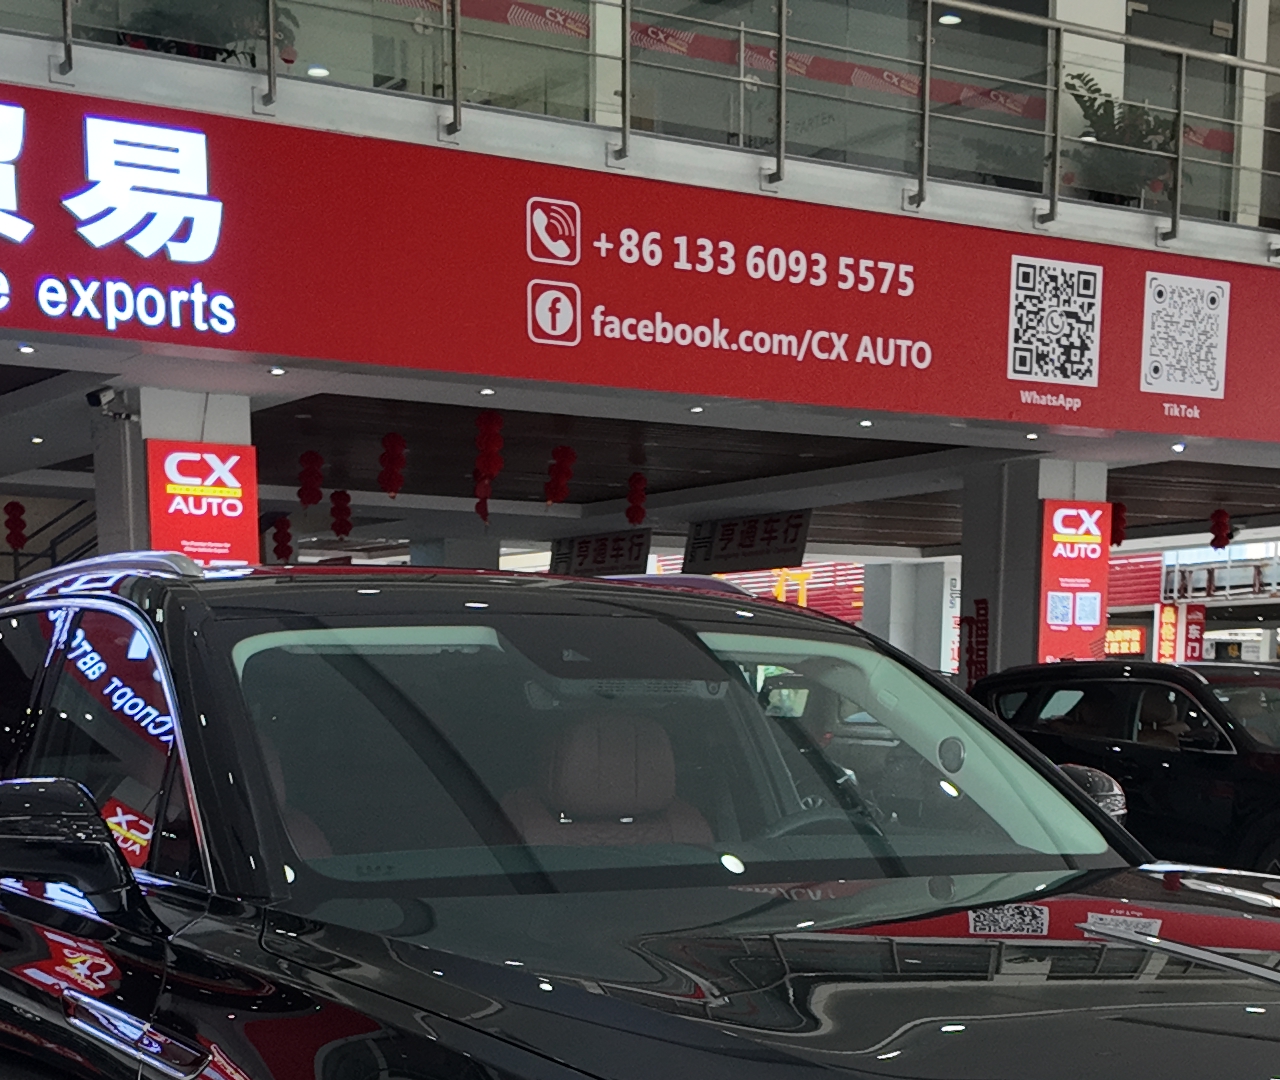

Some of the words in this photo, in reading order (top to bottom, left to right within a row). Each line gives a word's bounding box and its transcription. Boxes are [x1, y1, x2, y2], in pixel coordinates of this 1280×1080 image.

[593, 228, 663, 267] +86
[671, 235, 737, 277] 133
[746, 243, 828, 288] 6093
[837, 254, 916, 298] 5575
[37, 272, 237, 334] exports
[591, 304, 849, 364] facebook.com/CX
[856, 334, 933, 371] AUTO
[1020, 390, 1081, 411] WhatsApp
[1163, 403, 1200, 419] TikTok
[164, 452, 241, 488] CX
[168, 496, 243, 517] AUTO
[1052, 508, 1103, 536] CX
[1052, 543, 1102, 560] AUTO
